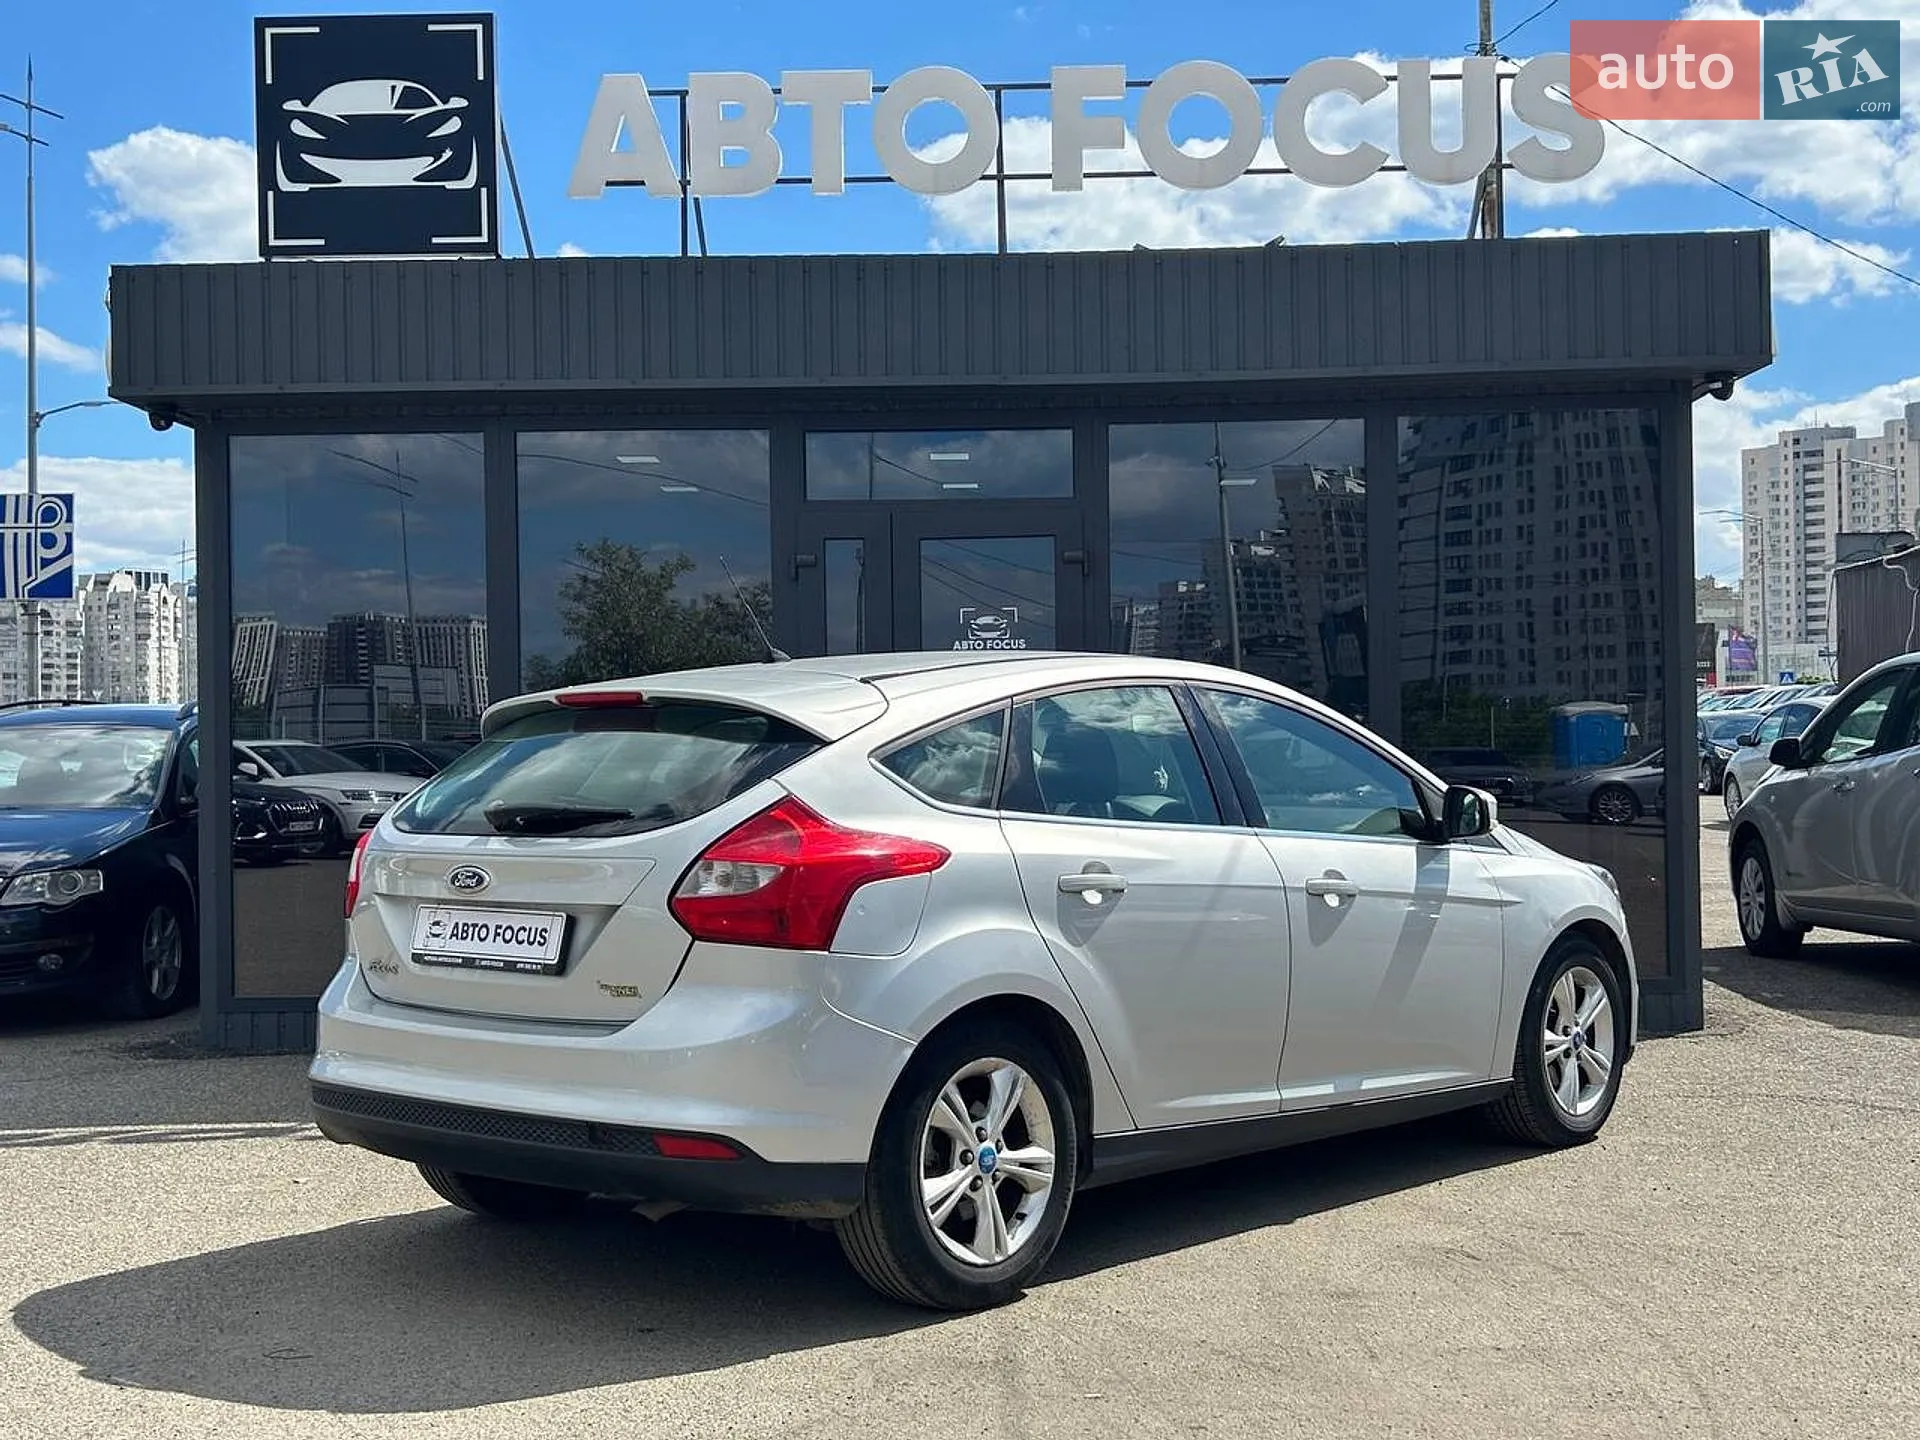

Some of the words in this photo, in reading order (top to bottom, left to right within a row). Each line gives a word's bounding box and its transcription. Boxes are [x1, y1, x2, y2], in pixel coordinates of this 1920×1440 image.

[568, 65, 999, 198] АВТО
[1051, 52, 1605, 192] FOCUS
[953, 640, 984, 650] АВТО
[986, 639, 1026, 650] FOCUS
[454, 871, 479, 887] Ford
[450, 921, 490, 942] АВТО
[492, 924, 549, 947] FOCUS
